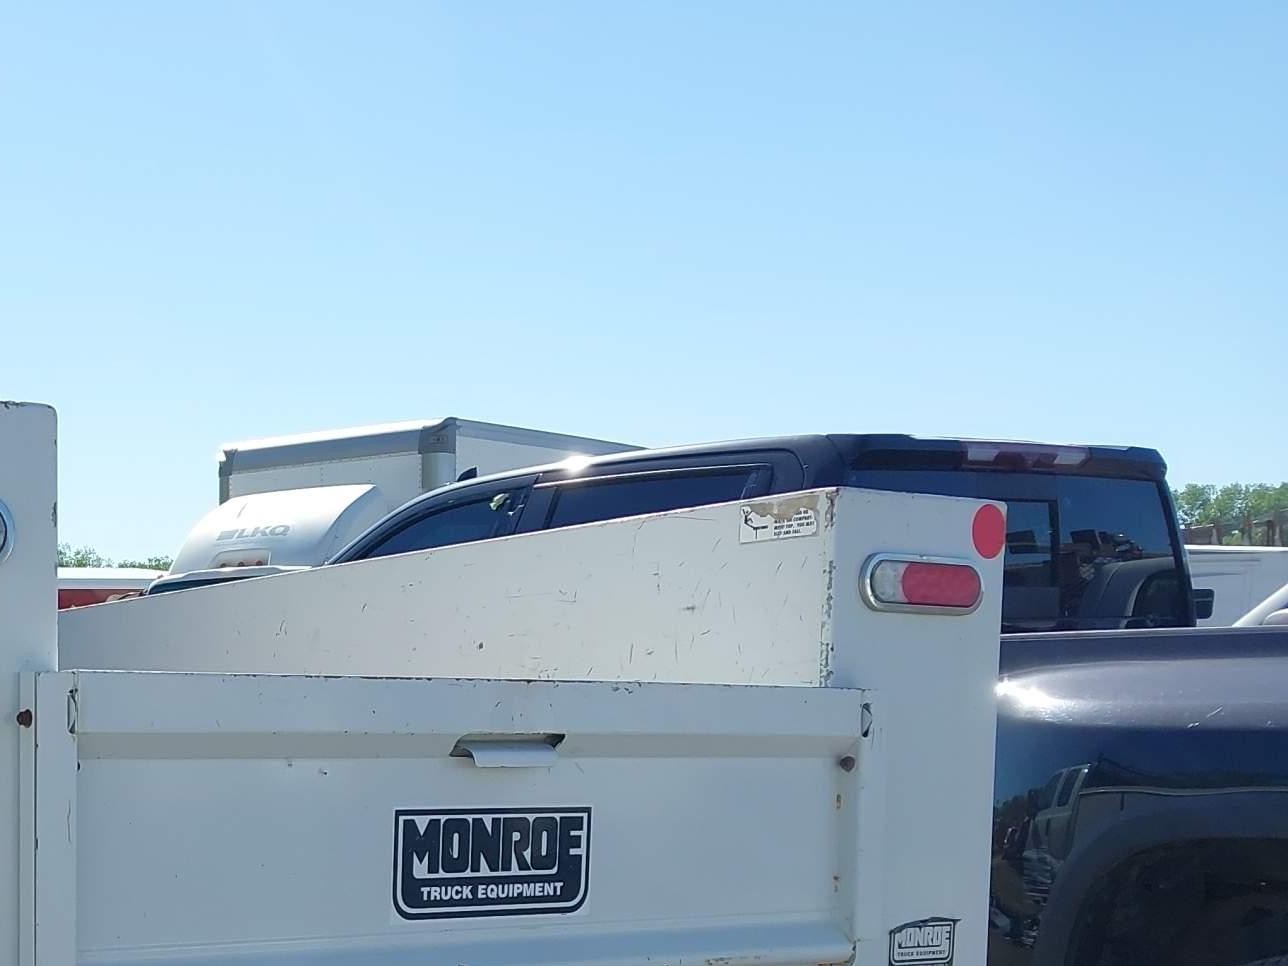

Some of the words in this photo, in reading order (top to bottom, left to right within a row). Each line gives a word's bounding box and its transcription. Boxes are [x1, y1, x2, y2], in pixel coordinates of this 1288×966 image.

[402, 816, 584, 875] MONROE
[420, 885, 473, 901] TRUCK
[478, 881, 564, 899] EQUIPMENT
[895, 926, 951, 949] MONROE
[916, 949, 946, 957] EQUIPMENT
